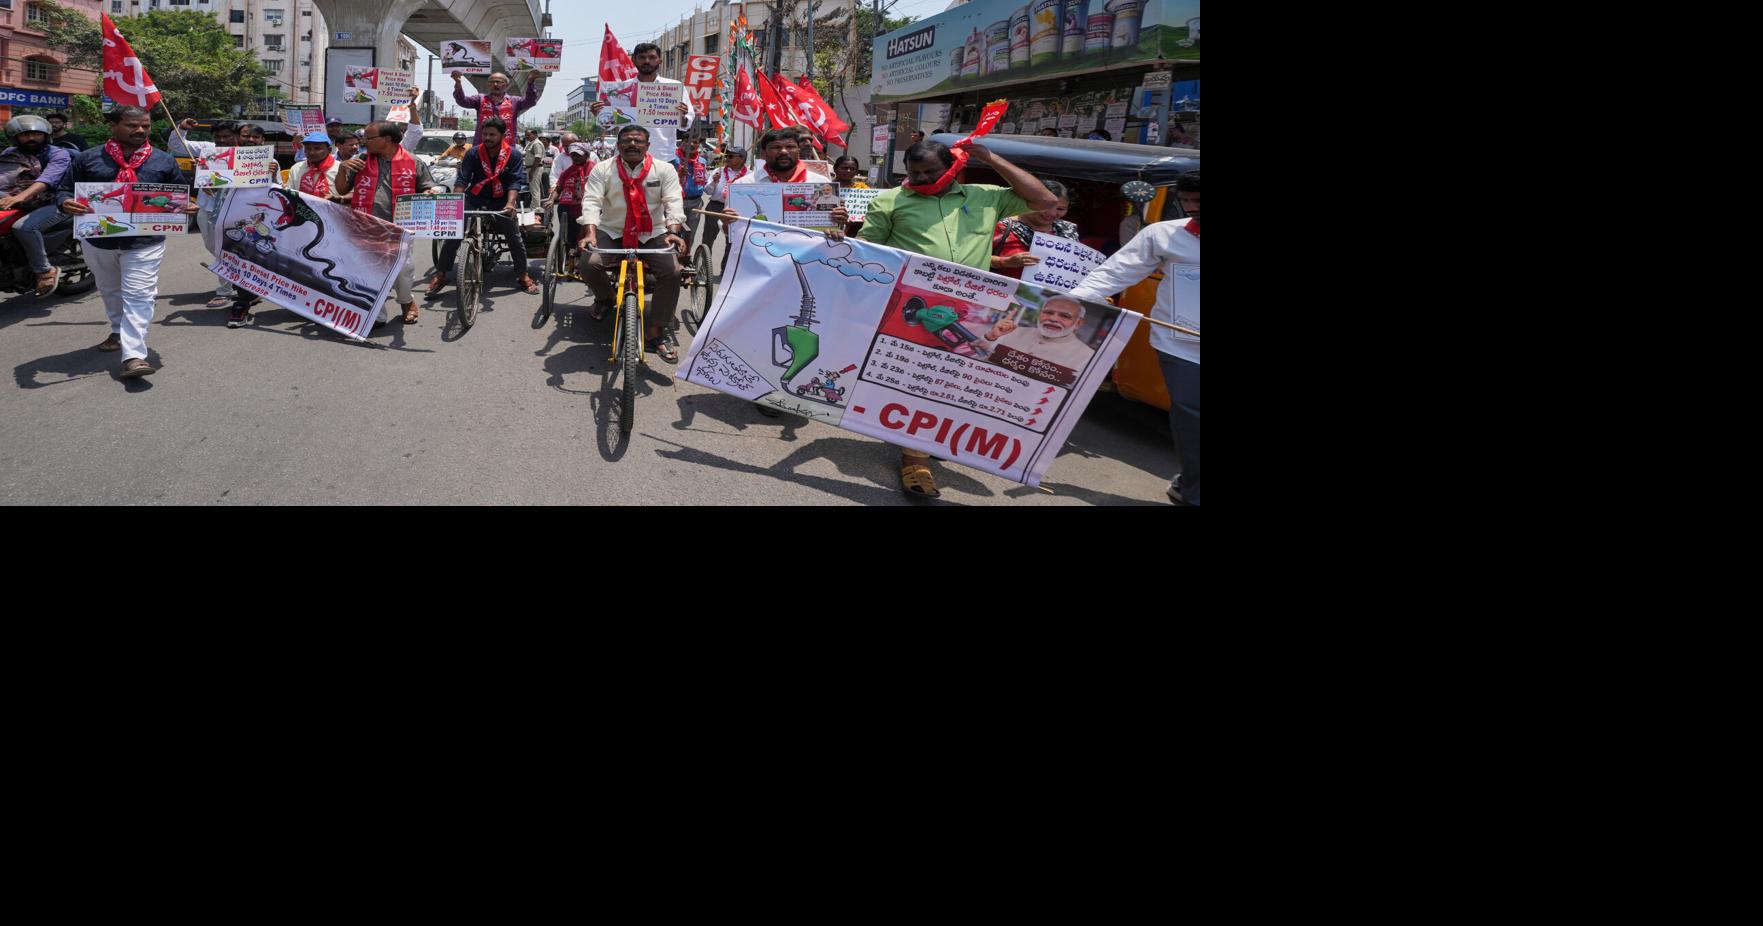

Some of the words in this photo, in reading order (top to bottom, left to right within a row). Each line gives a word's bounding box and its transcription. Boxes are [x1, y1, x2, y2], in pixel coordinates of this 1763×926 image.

[888, 31, 933, 57] HATSUN
[915, 59, 941, 71] COLOURS
[687, 57, 718, 100] CPM
[895, 71, 933, 84] PRESERVATIVES
[30, 94, 66, 105] BANK
[152, 224, 183, 232] CPM
[1035, 236, 1071, 253] పెంచిన
[1045, 256, 1080, 273] ధరలను
[223, 271, 240, 282] 7.50
[240, 278, 269, 297] Increase
[226, 266, 241, 275] Just
[243, 270, 251, 279] 10
[252, 274, 267, 288] Days
[275, 285, 297, 300] Times
[249, 264, 270, 279] Diesel
[271, 274, 290, 288] Price
[291, 283, 308, 296] Hike
[914, 269, 935, 281] కాబట్టి
[964, 280, 986, 292] డీజిల్
[986, 288, 1009, 298] ధరలు
[932, 283, 953, 293] కూడా
[313, 298, 362, 334] CPI(M)
[1007, 350, 1029, 362] దేశం
[696, 366, 721, 386] ధరలు
[879, 402, 1022, 471] CPI(M)
